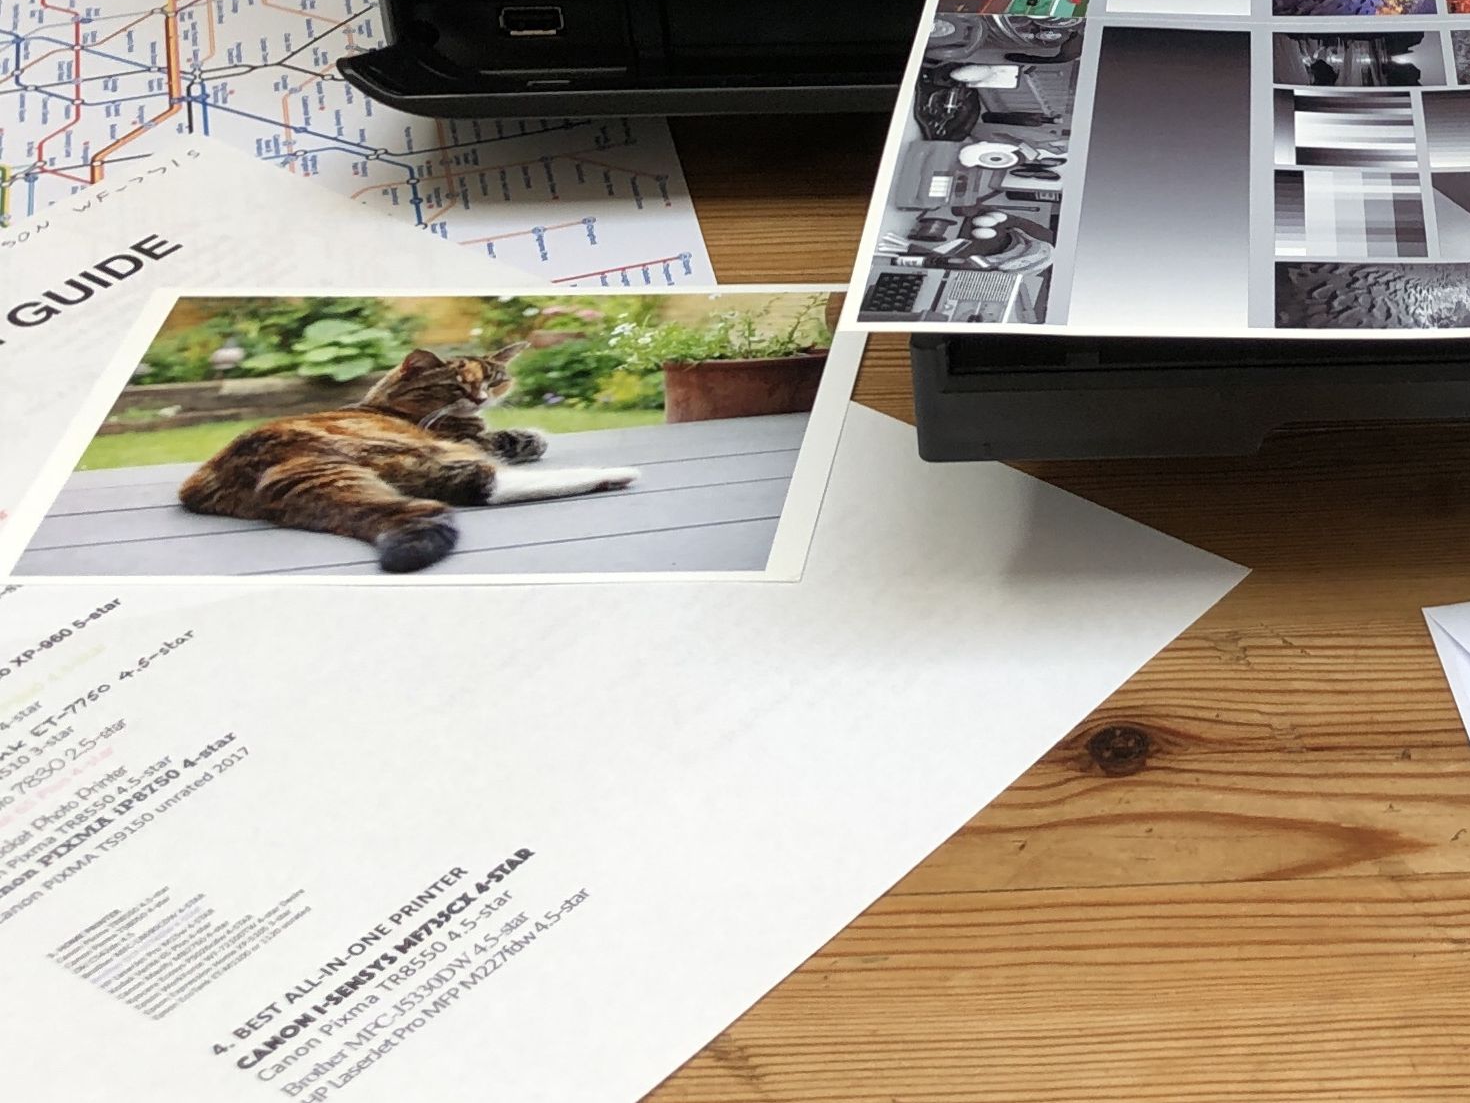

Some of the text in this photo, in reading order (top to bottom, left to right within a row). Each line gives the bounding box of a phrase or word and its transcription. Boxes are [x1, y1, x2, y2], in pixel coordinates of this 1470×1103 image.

[7, 234, 184, 327] GUIDE
[9, 597, 120, 667] XP-960 5-star
[29, 684, 110, 737] ET-7750
[118, 629, 193, 680] 4.5-star
[9, 757, 65, 794] 7830
[28, 725, 74, 755] 3-star
[5, 836, 57, 868] Pixma
[116, 755, 172, 794] 4.5-star
[29, 800, 79, 831] Photo
[73, 765, 127, 800] Printer
[35, 816, 114, 867] PIXMA
[111, 769, 180, 815] iP8750
[182, 732, 236, 768] 4-star
[41, 853, 99, 890] PIXMA
[94, 812, 154, 851] TS9150
[154, 771, 214, 813] unrated
[212, 746, 248, 773] 2017
[212, 867, 468, 1055] 4. BEST ALL-IN-ONE PRINTER
[236, 1012, 316, 1069] CANON
[311, 952, 397, 1015] I-SENSYS
[474, 848, 535, 894] 4-STAR
[256, 1037, 321, 1081] Canon
[318, 994, 380, 1036] Pixma
[447, 889, 512, 941] 4.5-star
[326, 1038, 399, 1088] LaserJet
[391, 1017, 426, 1040] Pro
[420, 987, 459, 1018] MFP
[457, 930, 536, 990] M227fdw
[534, 887, 589, 932] 4.5-star
[280, 1048, 348, 1096] Brother
